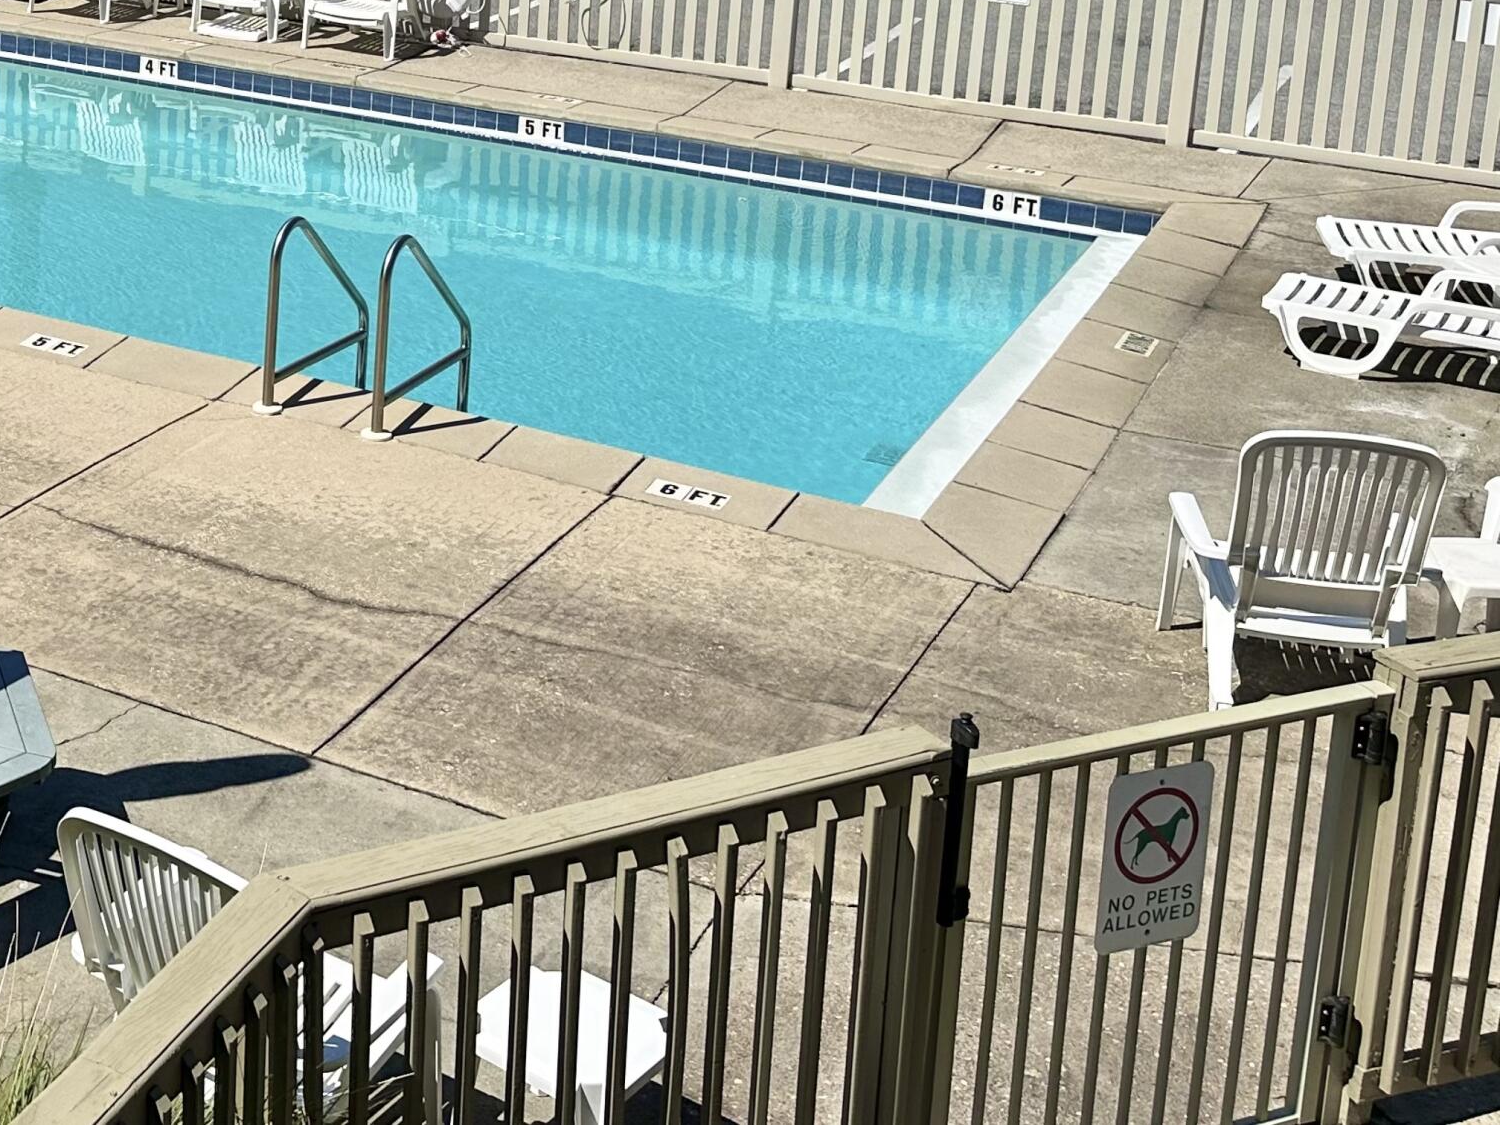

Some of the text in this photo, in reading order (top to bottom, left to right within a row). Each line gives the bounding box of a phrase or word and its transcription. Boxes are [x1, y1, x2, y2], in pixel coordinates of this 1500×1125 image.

[145, 59, 154, 74] 4
[525, 119, 535, 135] 5
[992, 193, 1004, 211] 6
[31, 336, 51, 347] 5
[659, 483, 680, 495] 6
[1107, 883, 1194, 914] NO PETS
[1102, 901, 1196, 934] ALLOWED
